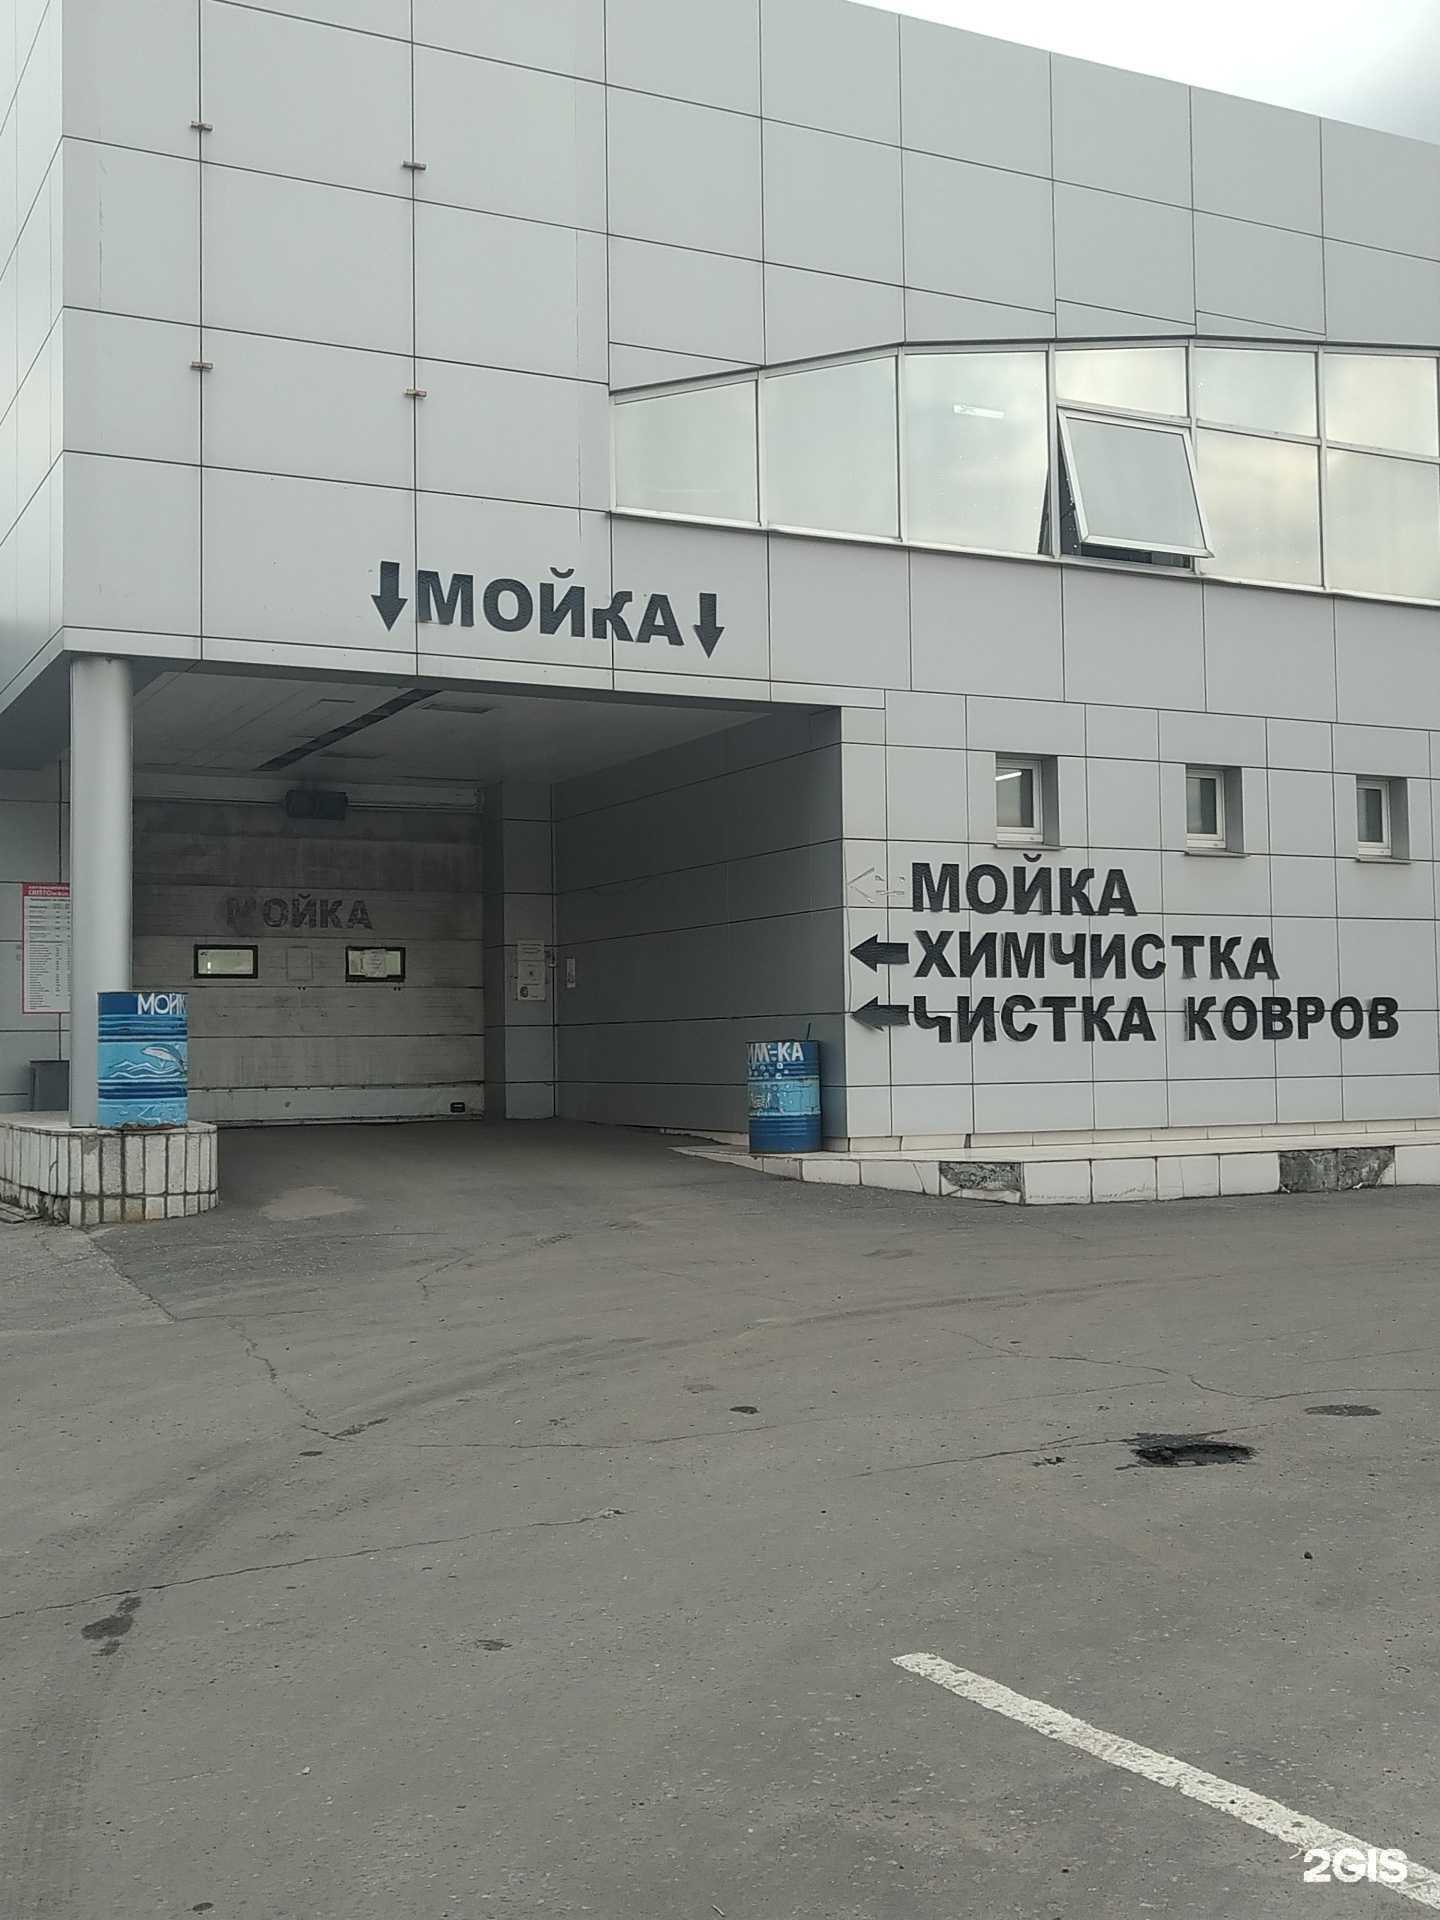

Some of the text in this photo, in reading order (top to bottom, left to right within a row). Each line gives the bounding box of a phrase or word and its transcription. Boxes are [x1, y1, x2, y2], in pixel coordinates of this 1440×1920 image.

[417, 566, 685, 646] МОЙКА
[912, 853, 1137, 915] МОЙКА
[913, 929, 1280, 981] ХИМЧИСТКА
[913, 994, 1400, 1043] ЧИСТКА КОВРОВ
